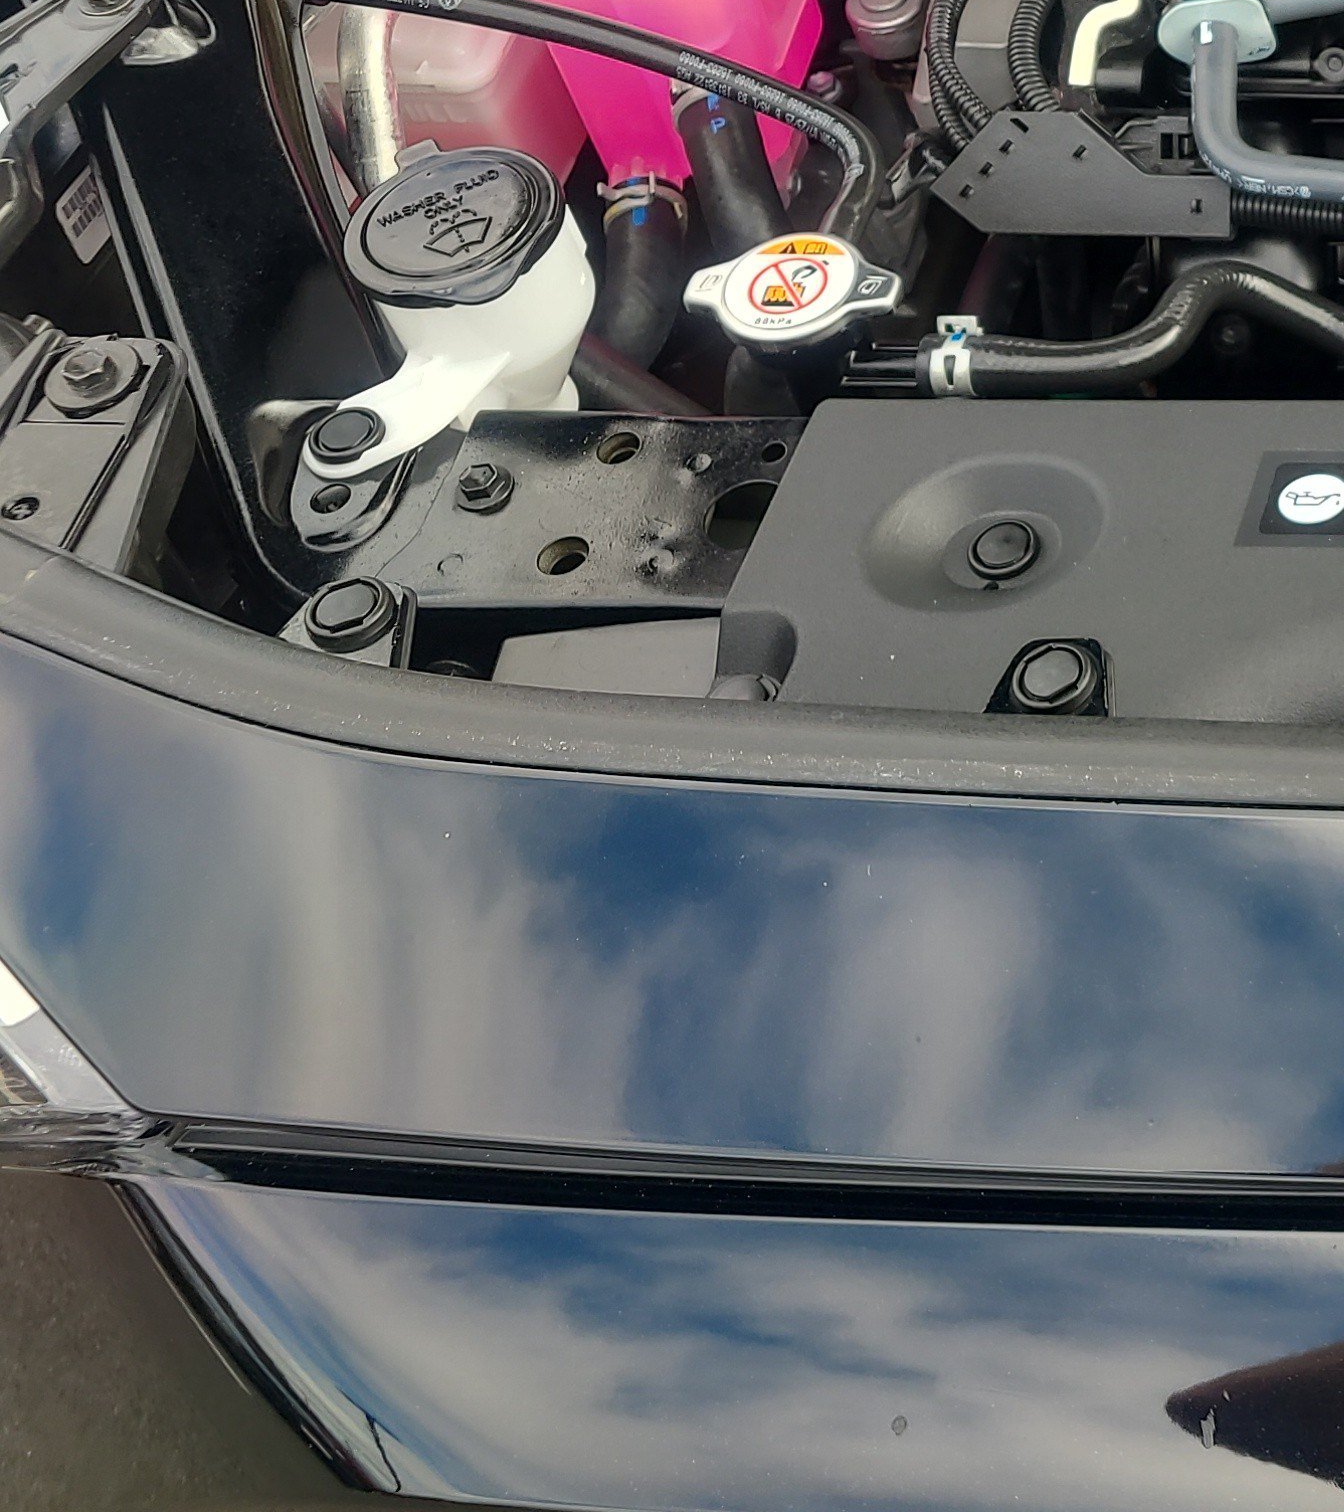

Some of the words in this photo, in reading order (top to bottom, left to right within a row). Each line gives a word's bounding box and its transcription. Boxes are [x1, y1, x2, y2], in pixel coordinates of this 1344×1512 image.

[376, 191, 447, 228] WASHER
[453, 169, 500, 194] FLUID
[423, 195, 463, 220] ONLY
